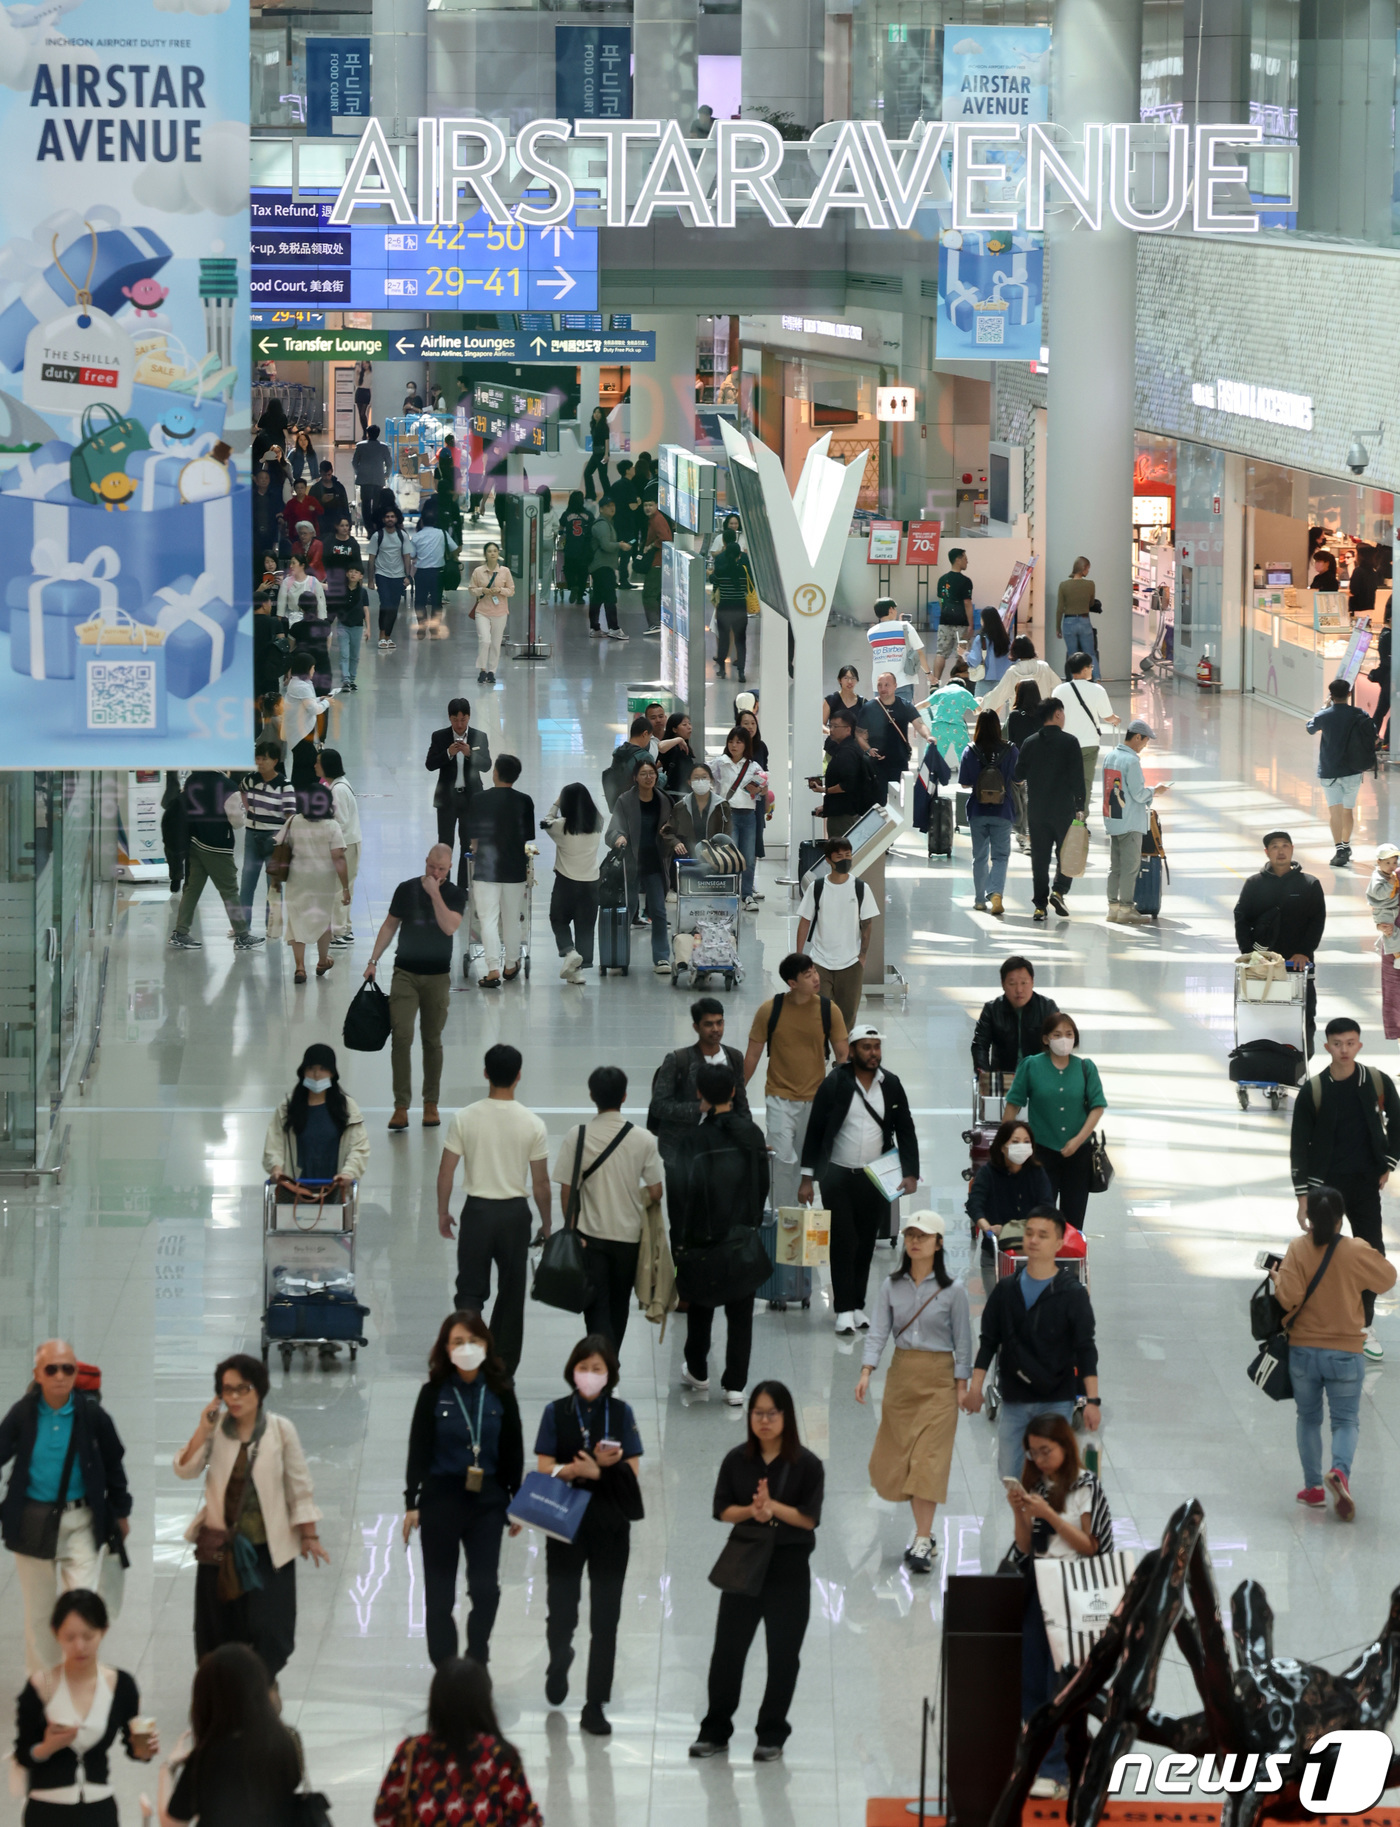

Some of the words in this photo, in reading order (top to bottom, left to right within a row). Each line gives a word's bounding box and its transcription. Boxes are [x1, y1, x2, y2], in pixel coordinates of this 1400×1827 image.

[45, 37, 93, 47] INCHEON
[96, 38, 138, 47] AIRPORT
[140, 39, 166, 48] DUTY
[168, 39, 191, 48] FREE
[330, 53, 339, 79] FOOD
[584, 44, 594, 75] FOOD
[30, 63, 207, 108] AIRSTAR
[343, 54, 362, 115] 푸드코
[599, 45, 621, 117] 푸드코
[961, 75, 1031, 93] AIRSTAR
[330, 81, 339, 112] COURT
[584, 78, 594, 114] COURT
[962, 97, 1029, 115] AVENUE
[36, 118, 202, 163] AVENUE
[328, 117, 796, 228] AIRSTAR
[797, 121, 1263, 232] AVENUE
[251, 204, 271, 216] Tax
[275, 204, 319, 217] Refund,
[425, 221, 525, 251] 42-50
[250, 280, 272, 292] ood
[274, 280, 308, 293] Court,
[310, 280, 344, 293] 美食街
[425, 266, 520, 297] 29-41
[283, 336, 333, 352] Transfer
[335, 337, 382, 355] Lounge
[420, 335, 461, 348] Airline
[464, 336, 515, 351] Lounges
[551, 339, 602, 353] 면세품인도장
[43, 348, 68, 360] THE
[72, 351, 121, 366] SHILLA
[441, 350, 463, 358] Airlines,
[44, 366, 77, 382] duty
[83, 372, 114, 384] free
[151, 364, 175, 376] SALE
[572, 520, 583, 537] 5
